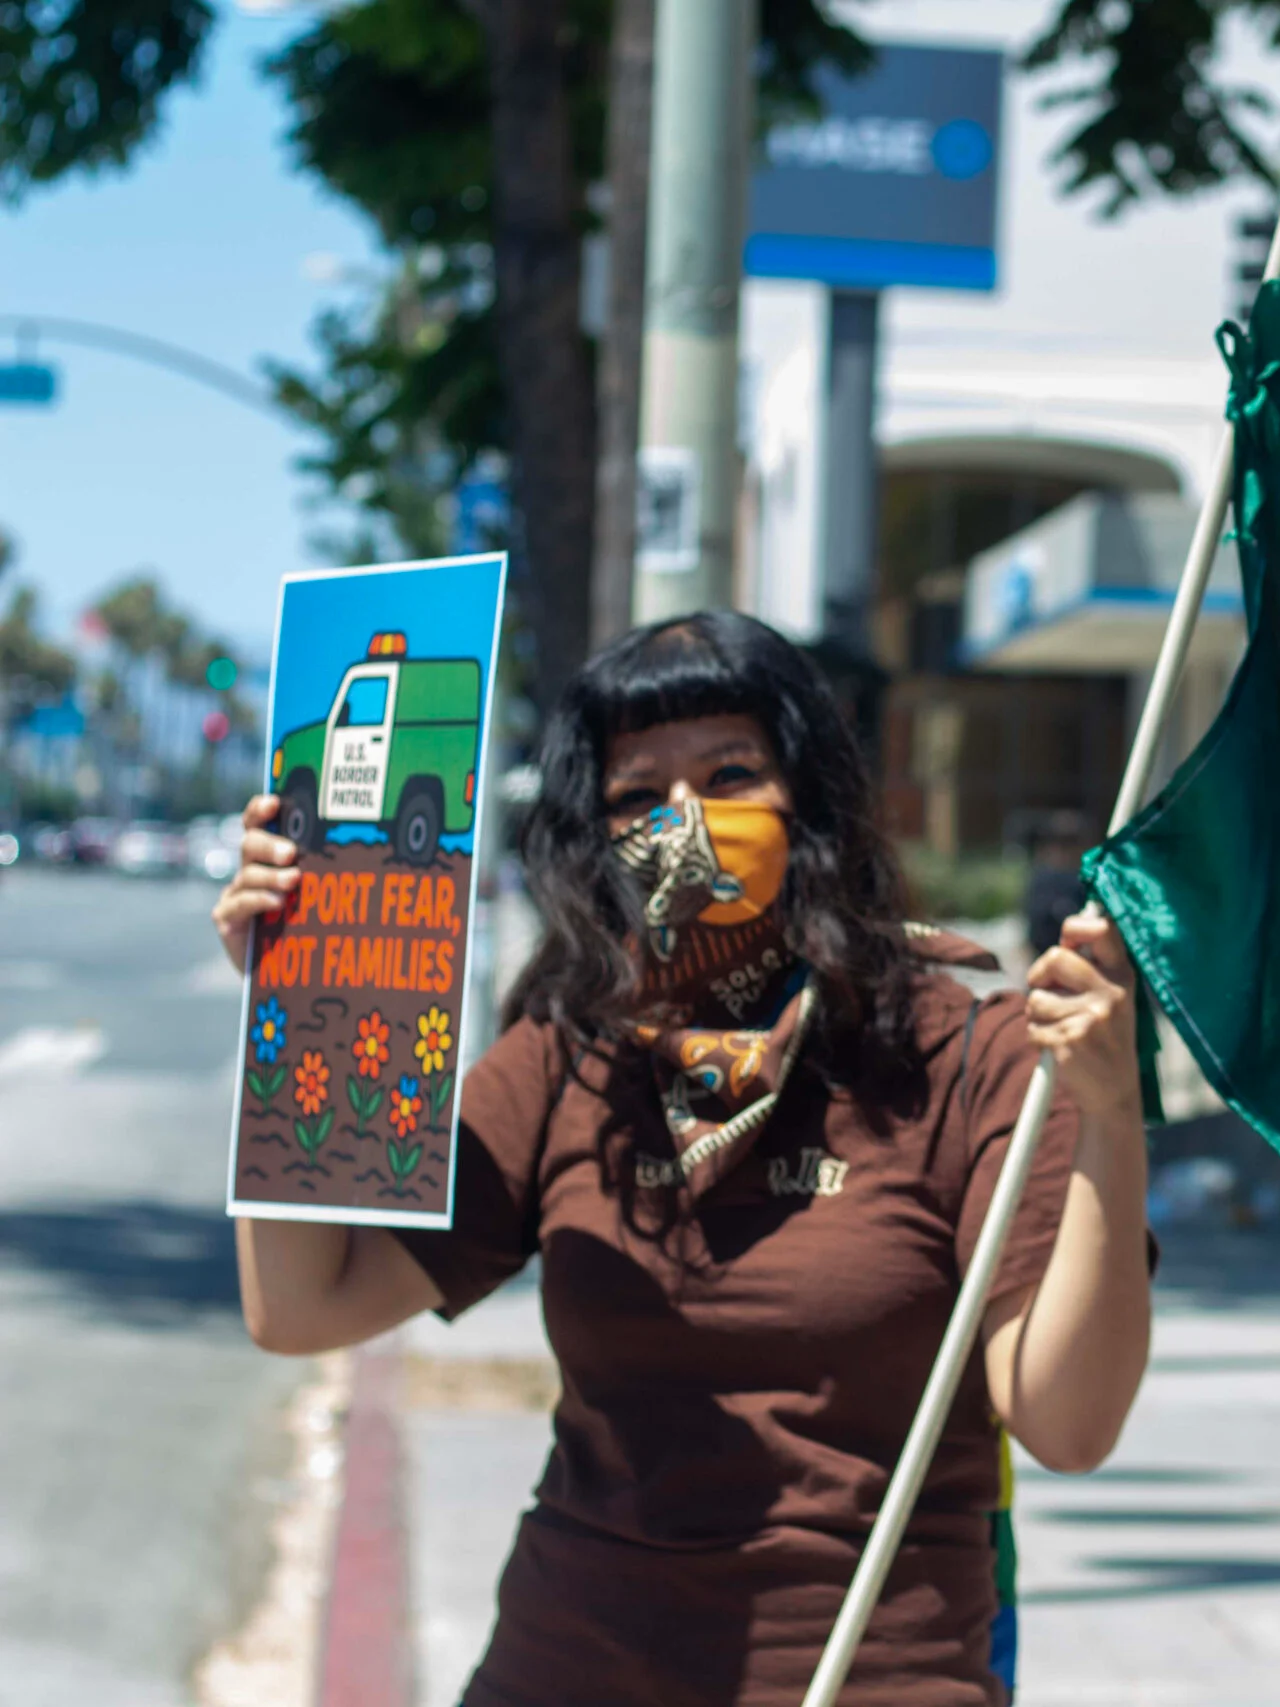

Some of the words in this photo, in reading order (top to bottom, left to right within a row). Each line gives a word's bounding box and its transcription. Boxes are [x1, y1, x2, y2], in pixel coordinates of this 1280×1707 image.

[767, 116, 931, 175] HASE
[330, 789, 374, 808] PATROL
[332, 765, 378, 784] BORDER
[381, 873, 462, 936] FEAR,
[259, 935, 317, 987] NOT
[322, 935, 455, 994] FAMILIES
